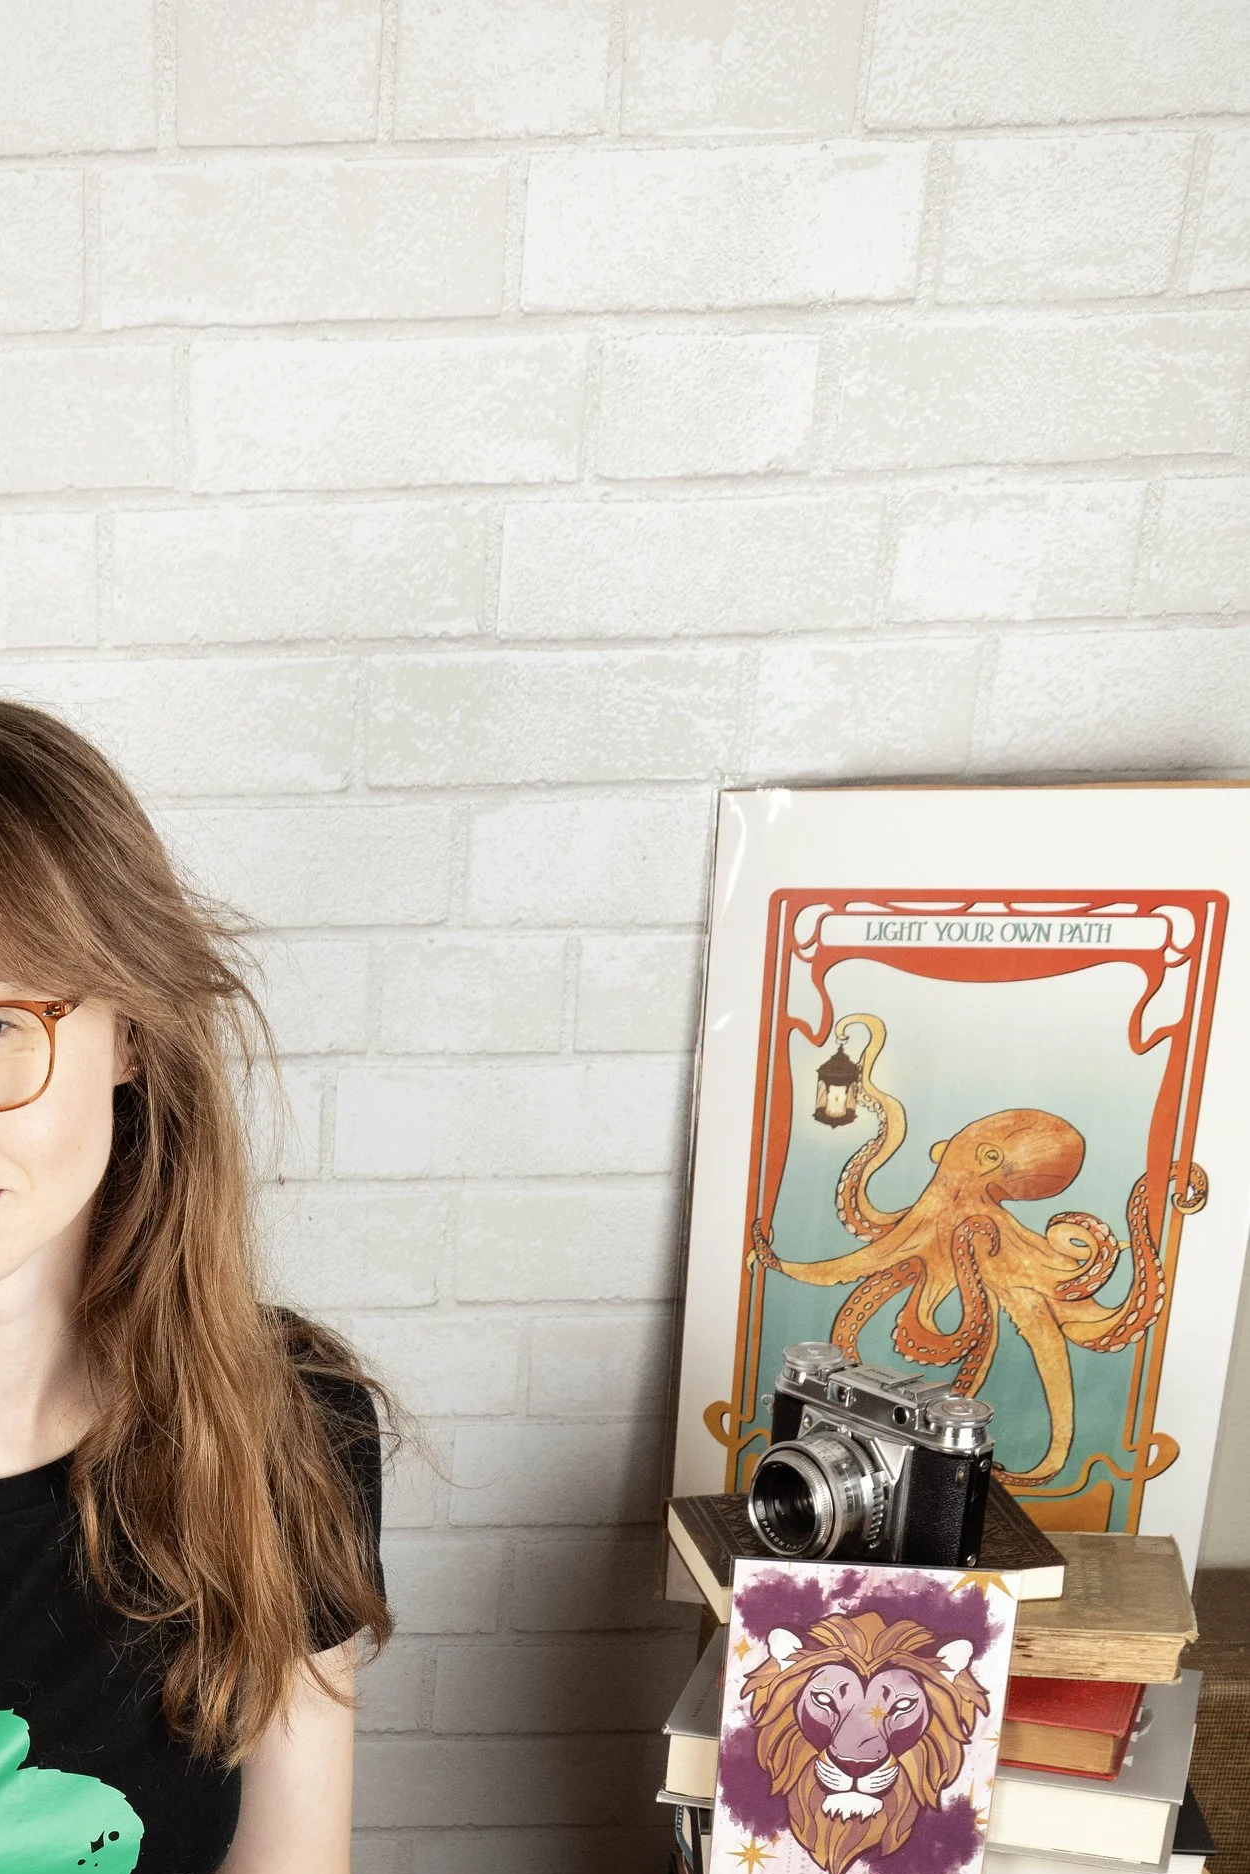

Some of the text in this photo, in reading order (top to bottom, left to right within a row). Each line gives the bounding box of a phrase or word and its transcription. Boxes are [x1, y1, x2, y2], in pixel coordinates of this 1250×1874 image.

[865, 921, 1113, 943] LIGHT YOUR OWN PATH
